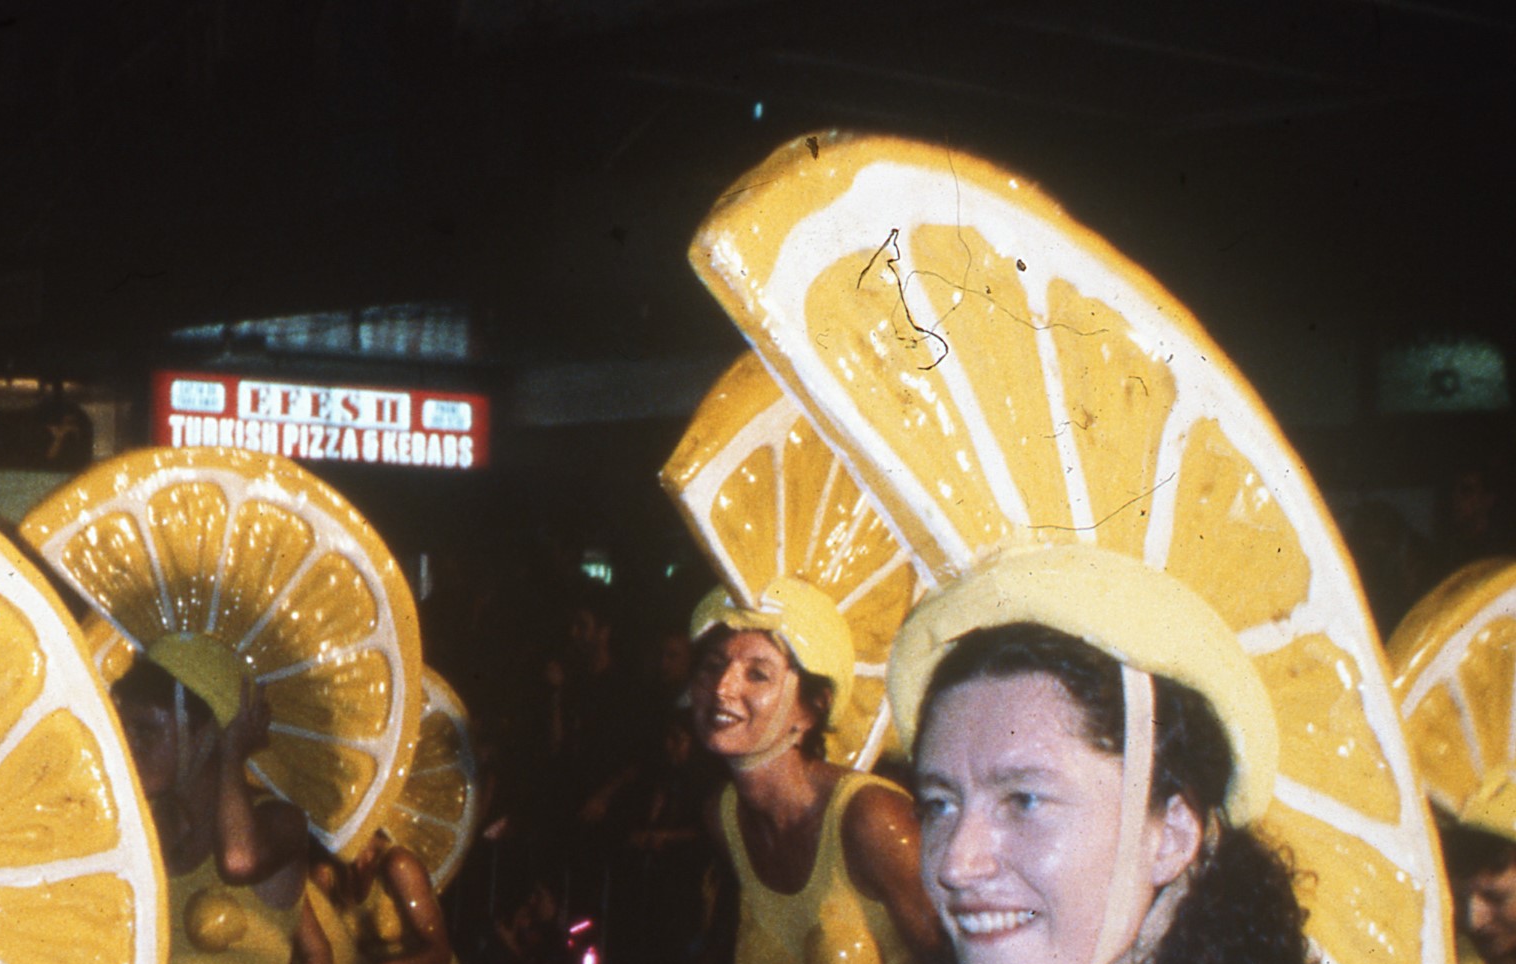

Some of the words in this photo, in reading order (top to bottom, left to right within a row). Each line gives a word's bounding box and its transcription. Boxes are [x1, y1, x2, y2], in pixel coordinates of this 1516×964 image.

[249, 387, 360, 420] EFES
[169, 414, 278, 456] TURKISH
[282, 422, 358, 462] PIZZA
[382, 430, 473, 469] KEBABS
